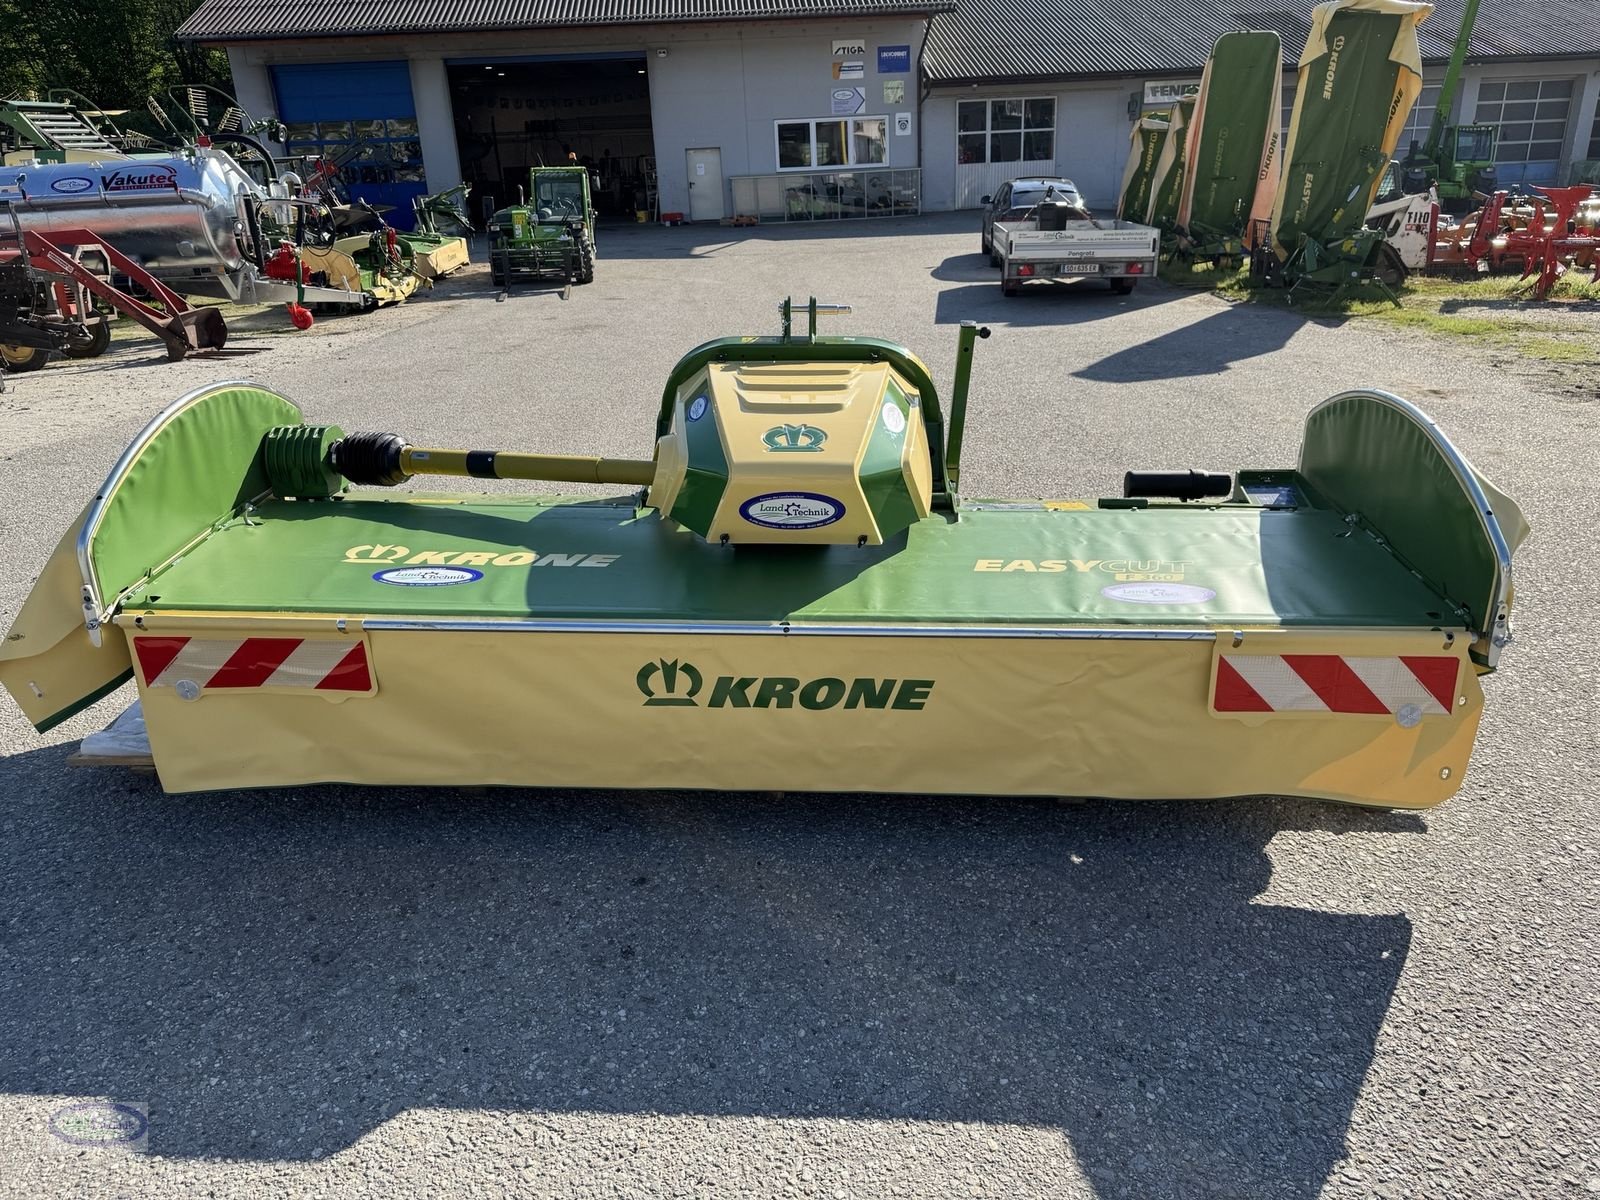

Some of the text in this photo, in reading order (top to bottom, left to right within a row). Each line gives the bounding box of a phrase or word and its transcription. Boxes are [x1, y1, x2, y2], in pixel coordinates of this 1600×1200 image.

[834, 46, 865, 54] STIGA
[1323, 51, 1338, 100] KRONE
[1150, 84, 1198, 96] FEN
[1388, 88, 1403, 124] ONE
[1264, 132, 1278, 170] KRONE
[101, 172, 176, 191] Vakutec
[760, 504, 829, 516] Land Technik
[404, 551, 622, 567] KRONE
[974, 559, 1194, 573] EASYCUT
[707, 676, 935, 710] KRONE
